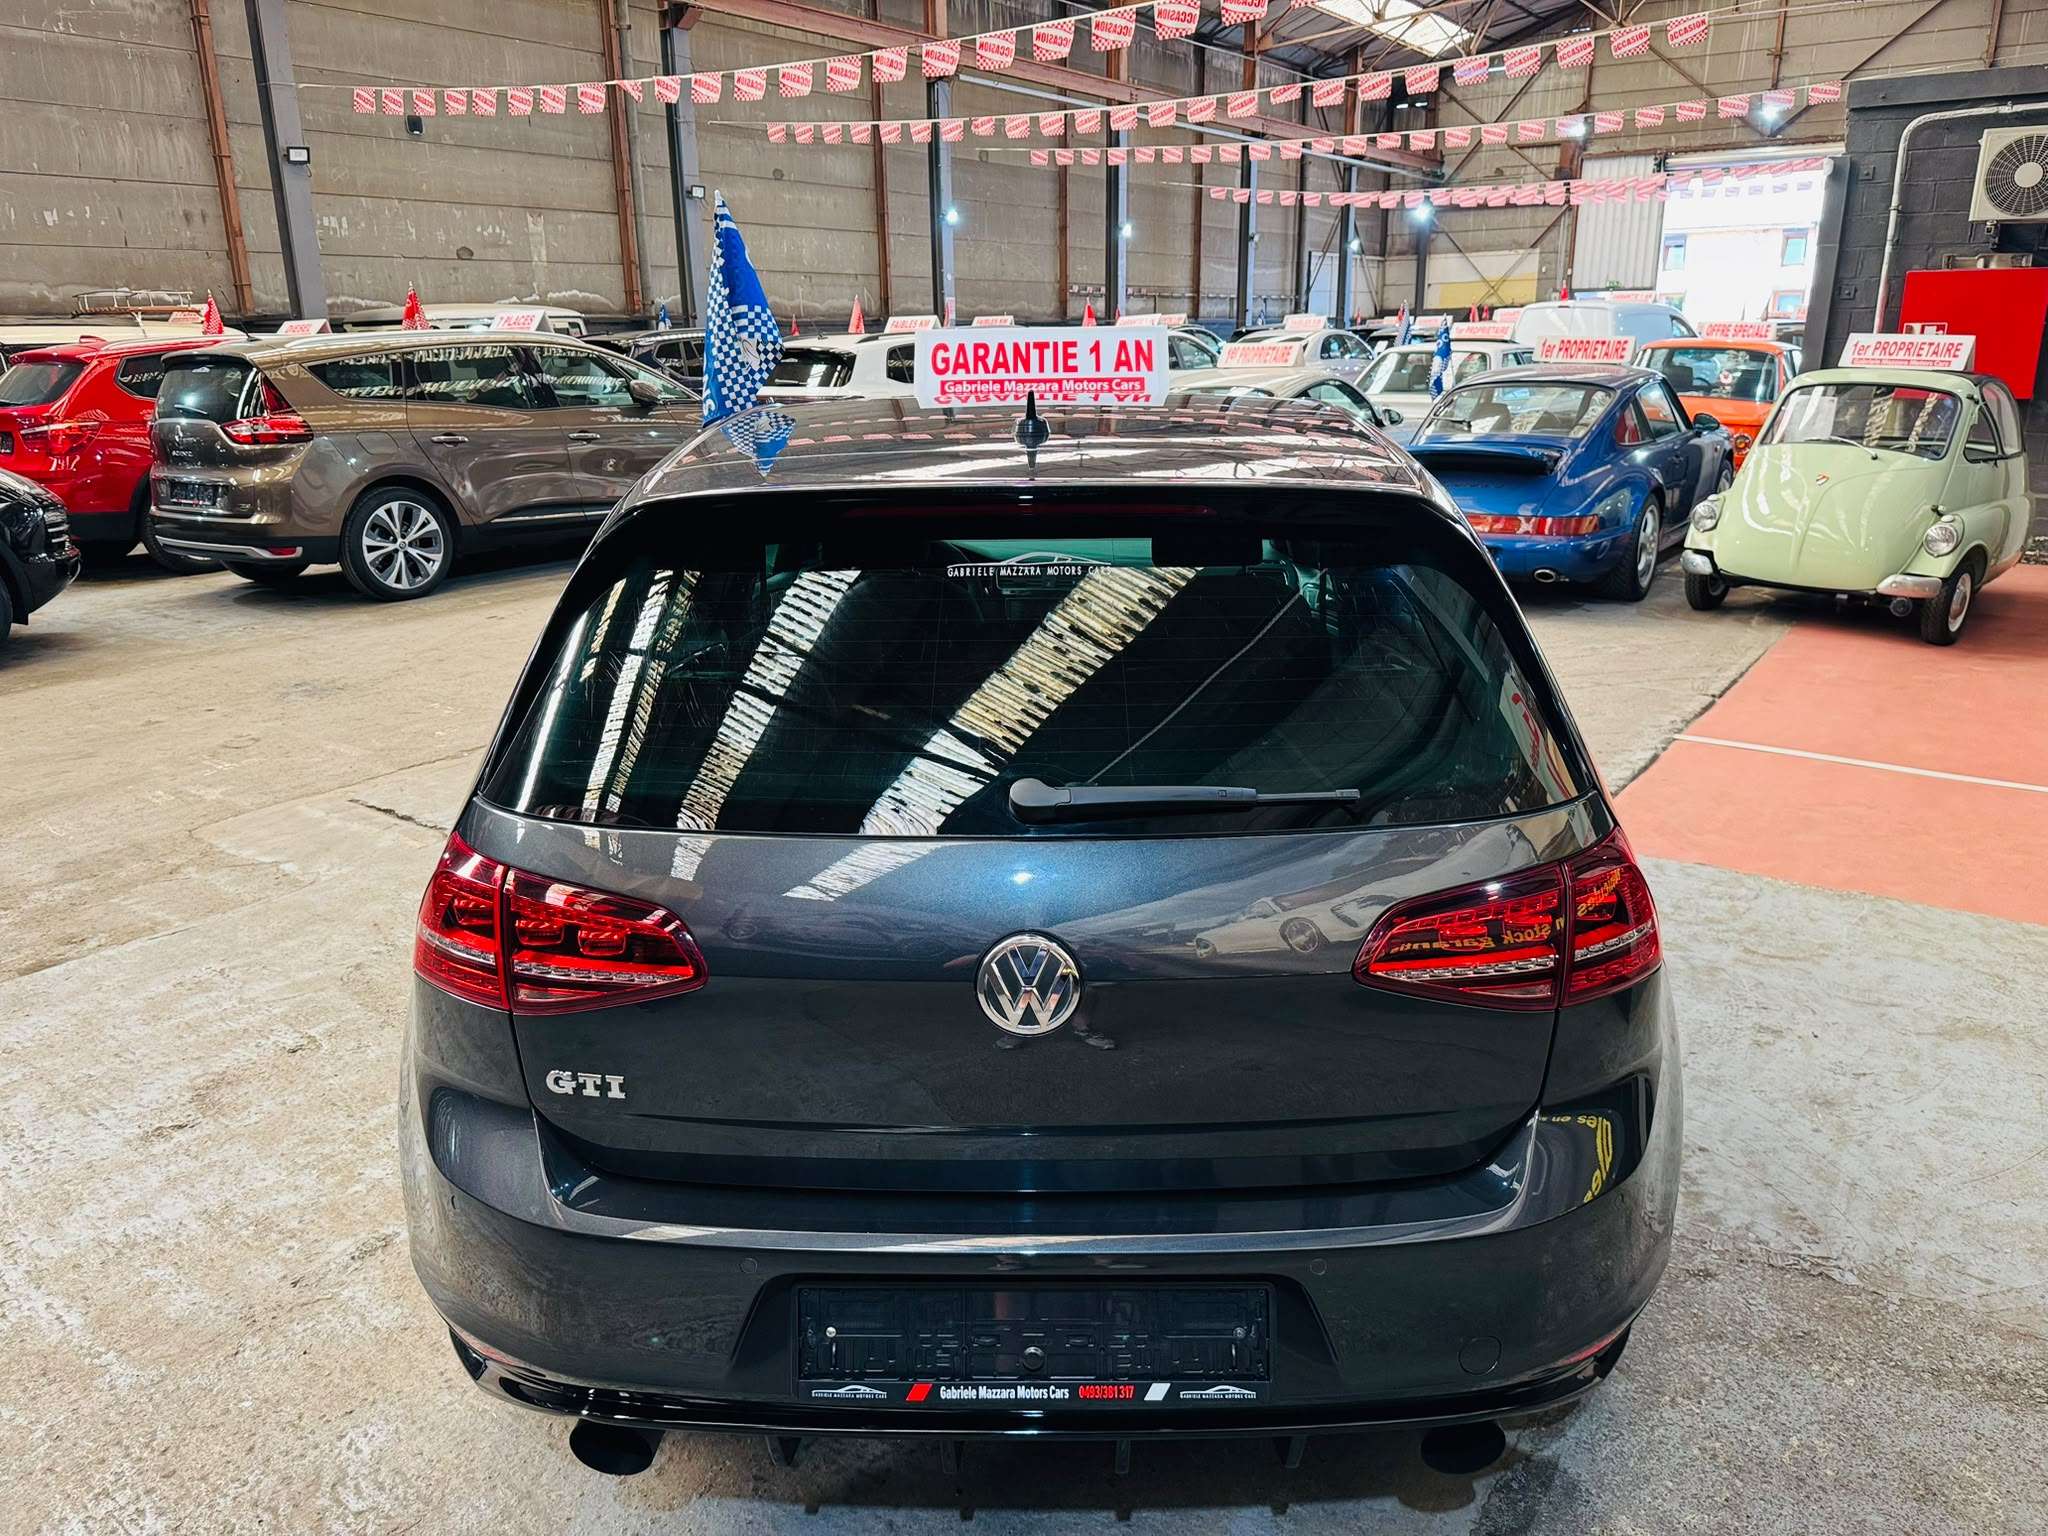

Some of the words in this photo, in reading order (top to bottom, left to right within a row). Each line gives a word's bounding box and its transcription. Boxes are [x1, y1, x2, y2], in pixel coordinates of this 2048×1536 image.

[1706, 323, 1732, 337] OFFRE
[1732, 323, 1772, 338] SPECIALE
[1541, 338, 1556, 358] 1er
[1556, 339, 1629, 360] PROPRIETAIRE
[1852, 341, 1871, 356] 1er
[1872, 341, 1963, 359] PROPRIETAIRE
[931, 341, 1078, 376] GARANTIE
[1089, 340, 1100, 373] 1
[1113, 339, 1154, 373] AN
[944, 380, 1000, 393] Gabriele
[1003, 380, 1059, 392] Mazzara
[1062, 379, 1109, 391] Motors
[1111, 378, 1141, 390] Cars
[947, 567, 994, 578] GABRIELE
[1000, 566, 1042, 576] MAZZARA
[1047, 565, 1082, 576] MOTORS
[546, 1069, 626, 1099] GTI
[940, 1385, 977, 1399] Gabriele
[978, 1385, 1016, 1399] Mazzara
[1017, 1385, 1049, 1399] Motors
[1050, 1385, 1070, 1399] Cars
